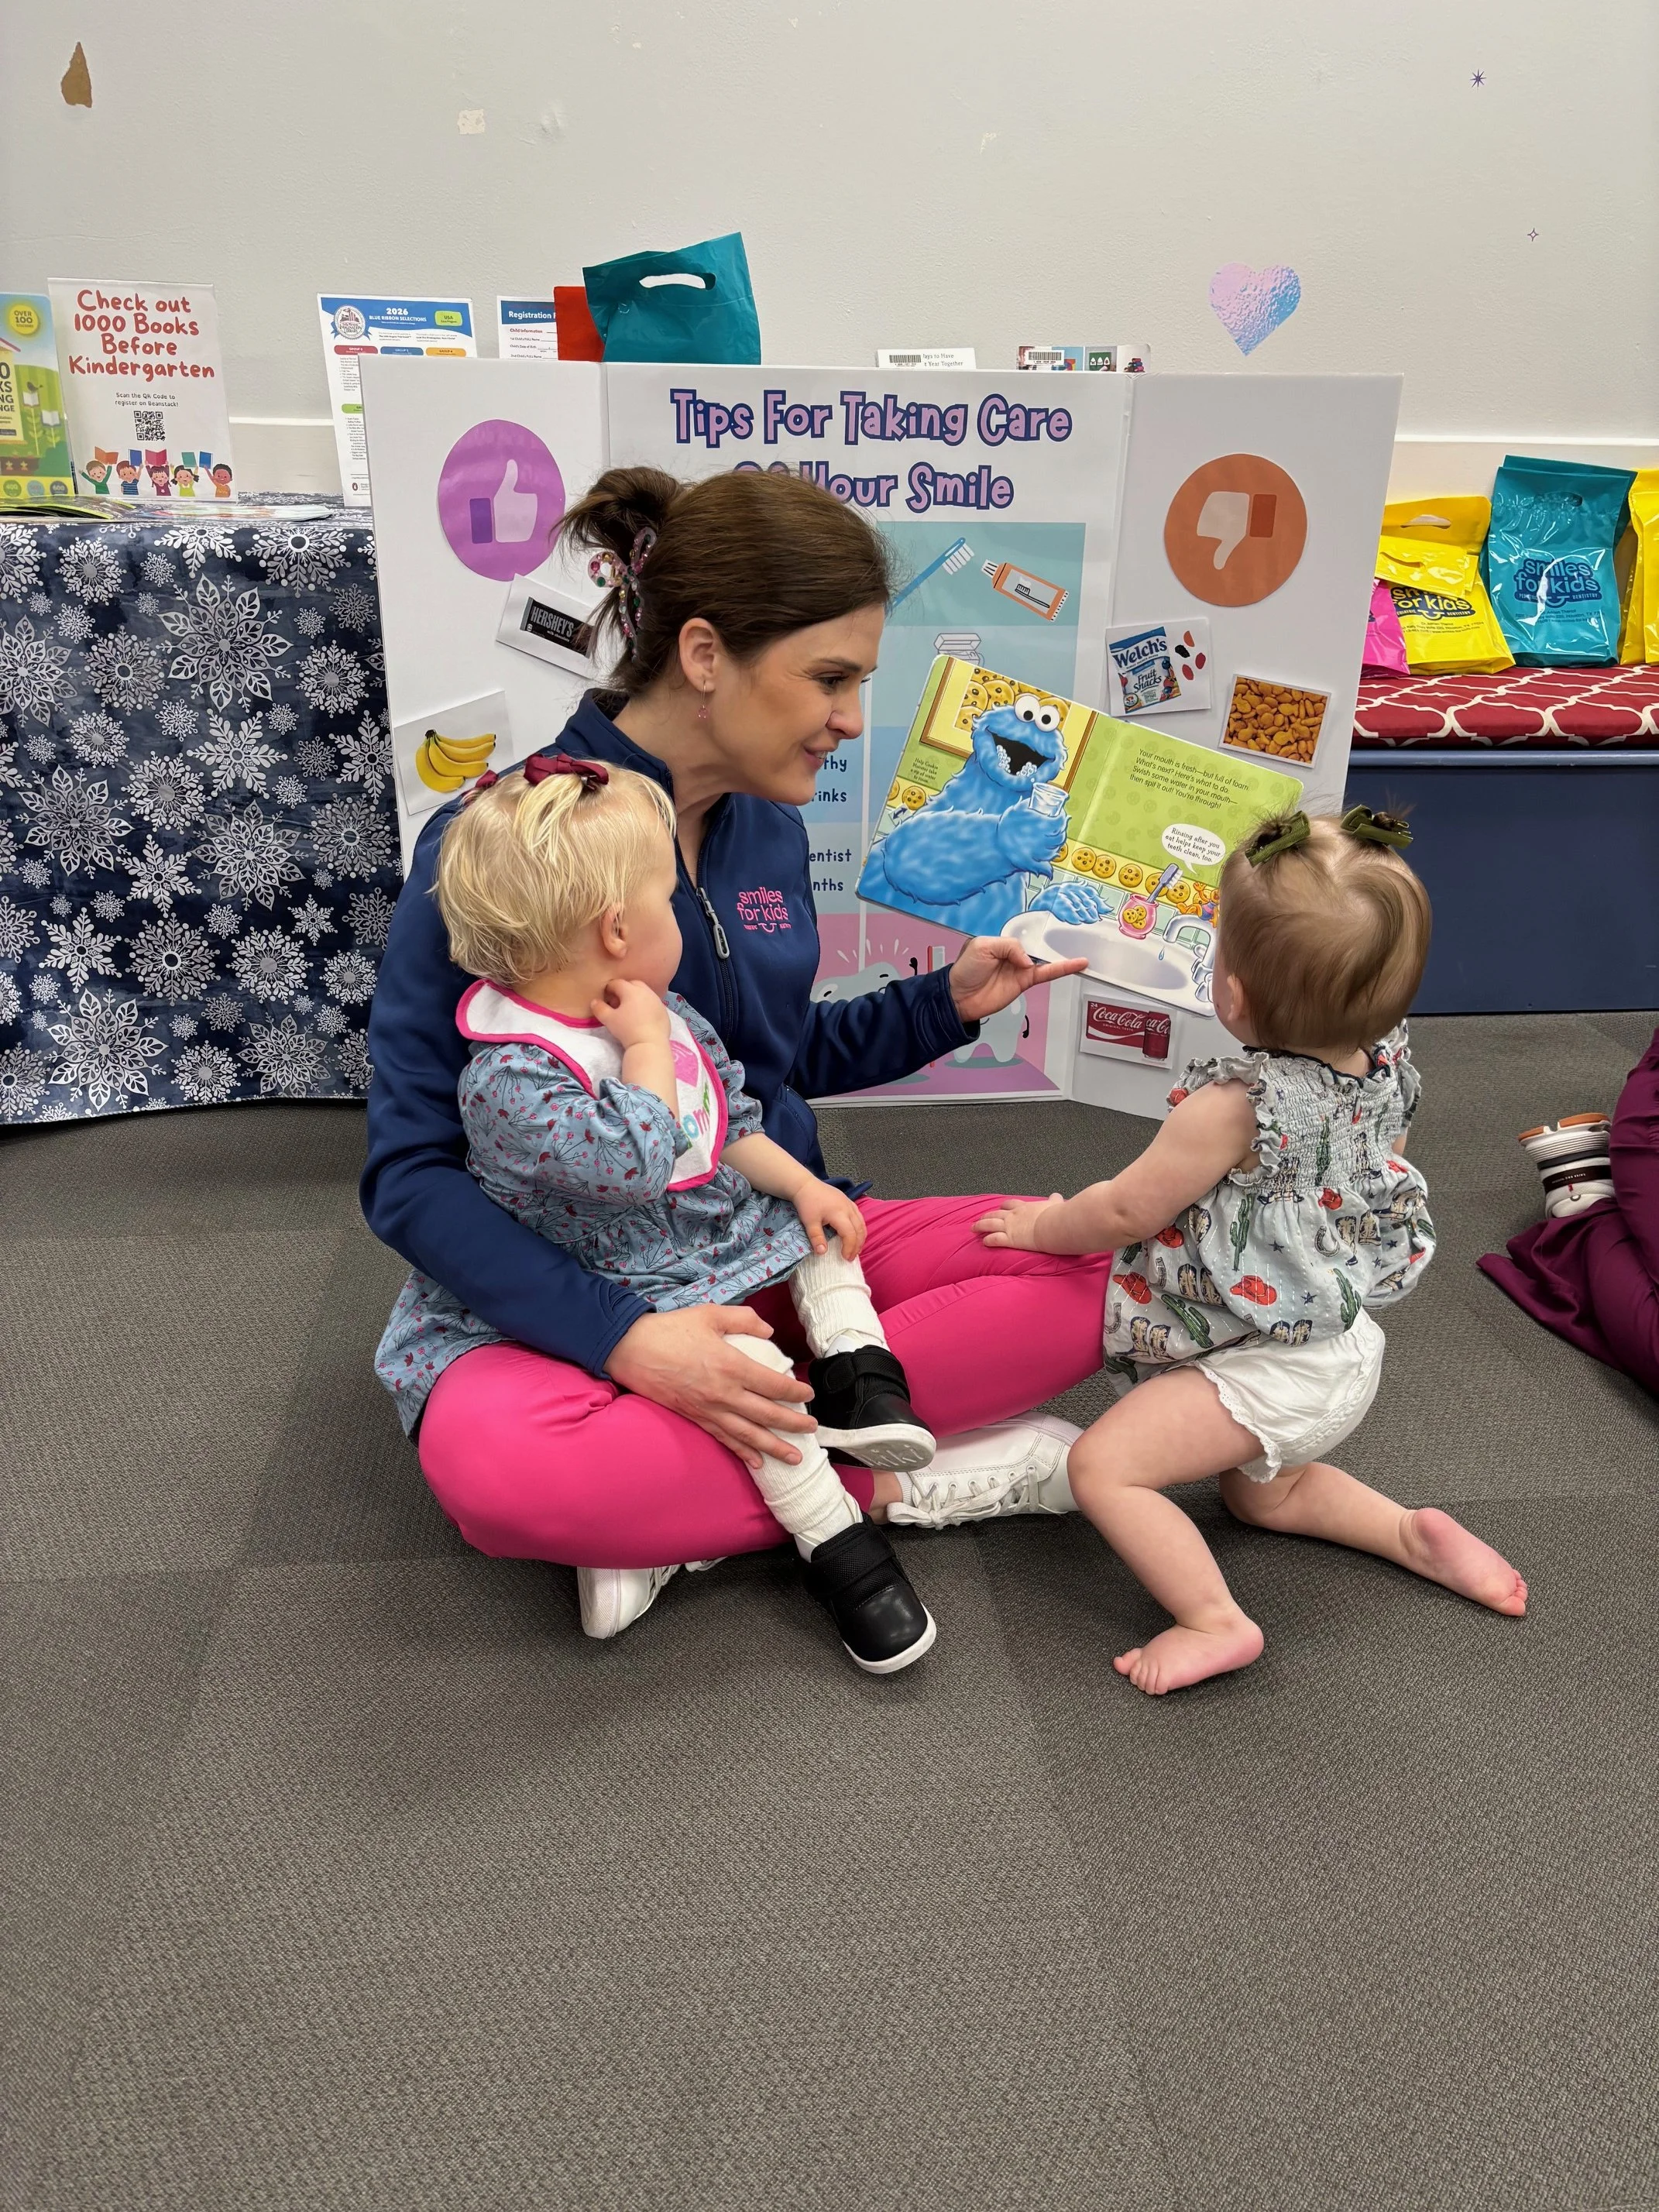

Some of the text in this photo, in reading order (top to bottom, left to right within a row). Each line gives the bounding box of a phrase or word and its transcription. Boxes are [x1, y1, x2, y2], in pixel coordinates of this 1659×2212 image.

[77, 290, 191, 313] Check out
[74, 312, 199, 335] 1000 Books
[509, 311, 551, 319] Registration
[101, 333, 177, 356] Before
[69, 356, 215, 382] Kindergarten
[670, 388, 1073, 448] Tips For Taking Care
[905, 461, 1014, 514] Smile
[1524, 559, 1591, 576] smiles
[1550, 576, 1599, 593] kids
[531, 606, 575, 637] HERSHEY'S
[1112, 638, 1167, 668] Welch's
[1133, 675, 1162, 693] Snacks
[1138, 669, 1156, 684] Fruit
[1135, 757, 1156, 769] What's
[1157, 765, 1174, 775] next?
[1175, 771, 1194, 782] Here's
[1196, 778, 1211, 788] what
[1139, 748, 1153, 759] Your
[1154, 754, 1174, 766] mouth
[1214, 774, 1224, 782] full
[1129, 774, 1144, 784] then
[1145, 779, 1156, 788] spit
[1175, 789, 1194, 801] You're
[1195, 795, 1221, 809] through!
[1132, 765, 1150, 777] Swish
[1152, 772, 1169, 782] some
[1170, 778, 1188, 789] water
[1195, 787, 1210, 796] your
[812, 788, 847, 802] rinks
[1171, 827, 1193, 840] Rinsing
[809, 849, 852, 862] entist
[1167, 843, 1182, 852] teeth
[1183, 848, 1200, 860] clean,
[1176, 836, 1191, 847] helps
[1193, 843, 1206, 853] keep
[1207, 849, 1221, 857] your
[739, 886, 783, 905] smiles
[812, 878, 843, 891] nths
[737, 902, 788, 921] for kids
[1093, 1006, 1146, 1029] Coca-Cola
